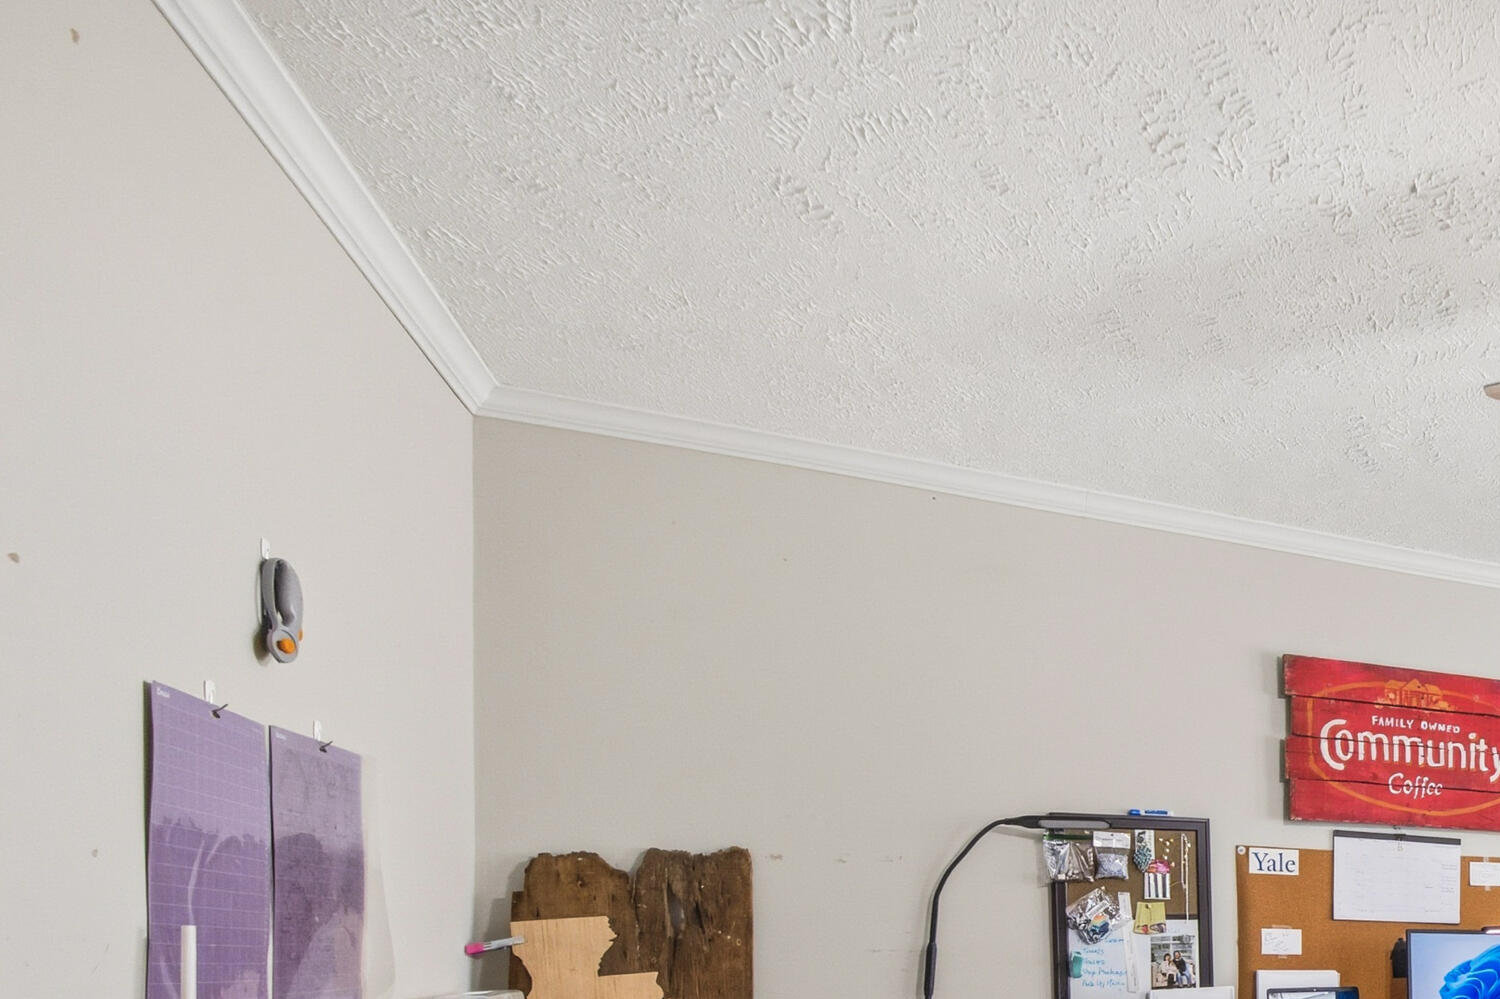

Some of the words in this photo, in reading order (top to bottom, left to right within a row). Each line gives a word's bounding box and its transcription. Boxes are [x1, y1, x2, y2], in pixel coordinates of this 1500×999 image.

[1371, 715, 1414, 729] FAMILY
[1420, 720, 1461, 734] OWNED
[1388, 772, 1443, 799] Coffee
[1252, 851, 1296, 873] Yale
